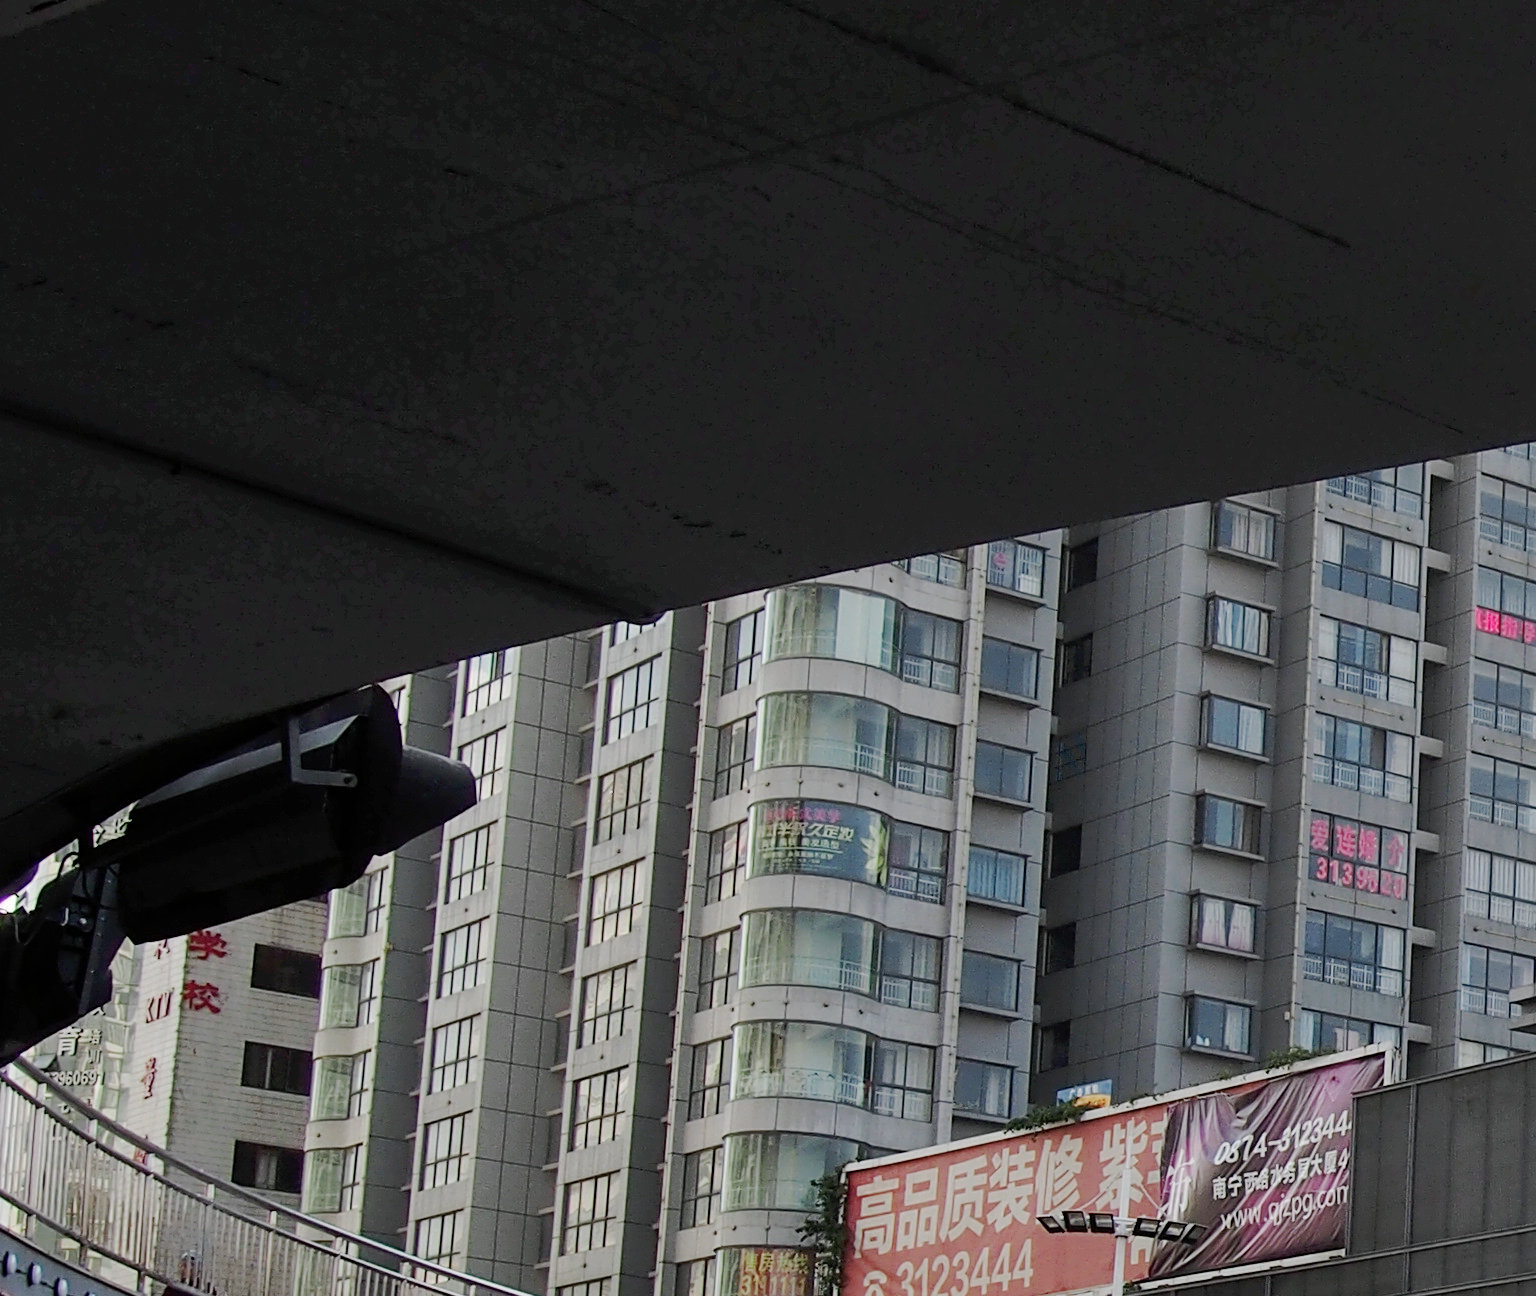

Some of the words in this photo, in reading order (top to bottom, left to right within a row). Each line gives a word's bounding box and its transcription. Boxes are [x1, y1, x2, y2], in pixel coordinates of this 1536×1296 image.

[853, 1134, 1083, 1259] 高品质装修
